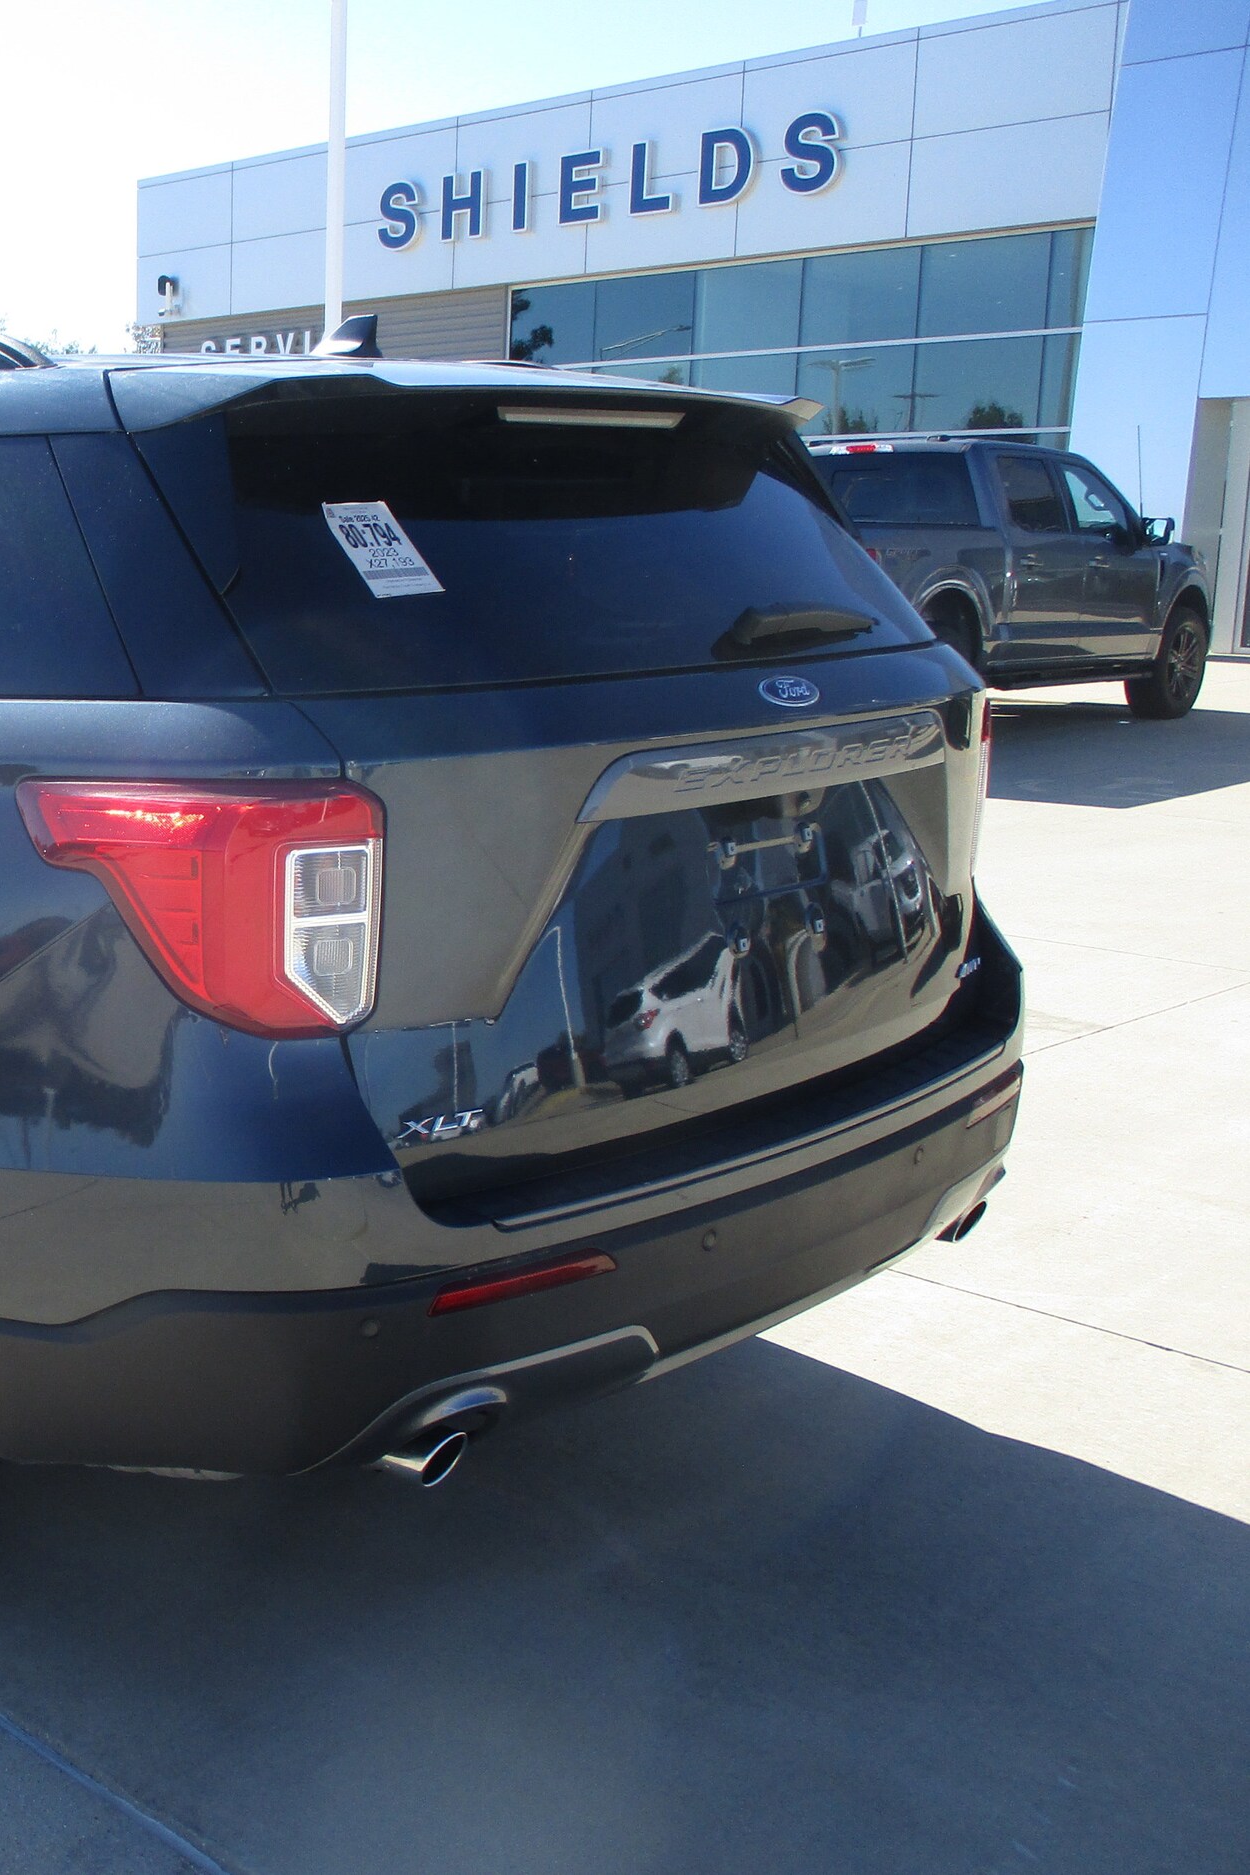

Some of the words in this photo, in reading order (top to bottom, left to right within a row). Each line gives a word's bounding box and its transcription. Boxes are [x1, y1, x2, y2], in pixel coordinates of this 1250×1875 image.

[378, 109, 843, 253] SHIELDS
[369, 548, 399, 558] 2023
[775, 679, 810, 699] Ford
[674, 735, 913, 793] EXPLORER
[397, 1108, 484, 1139] XLT
